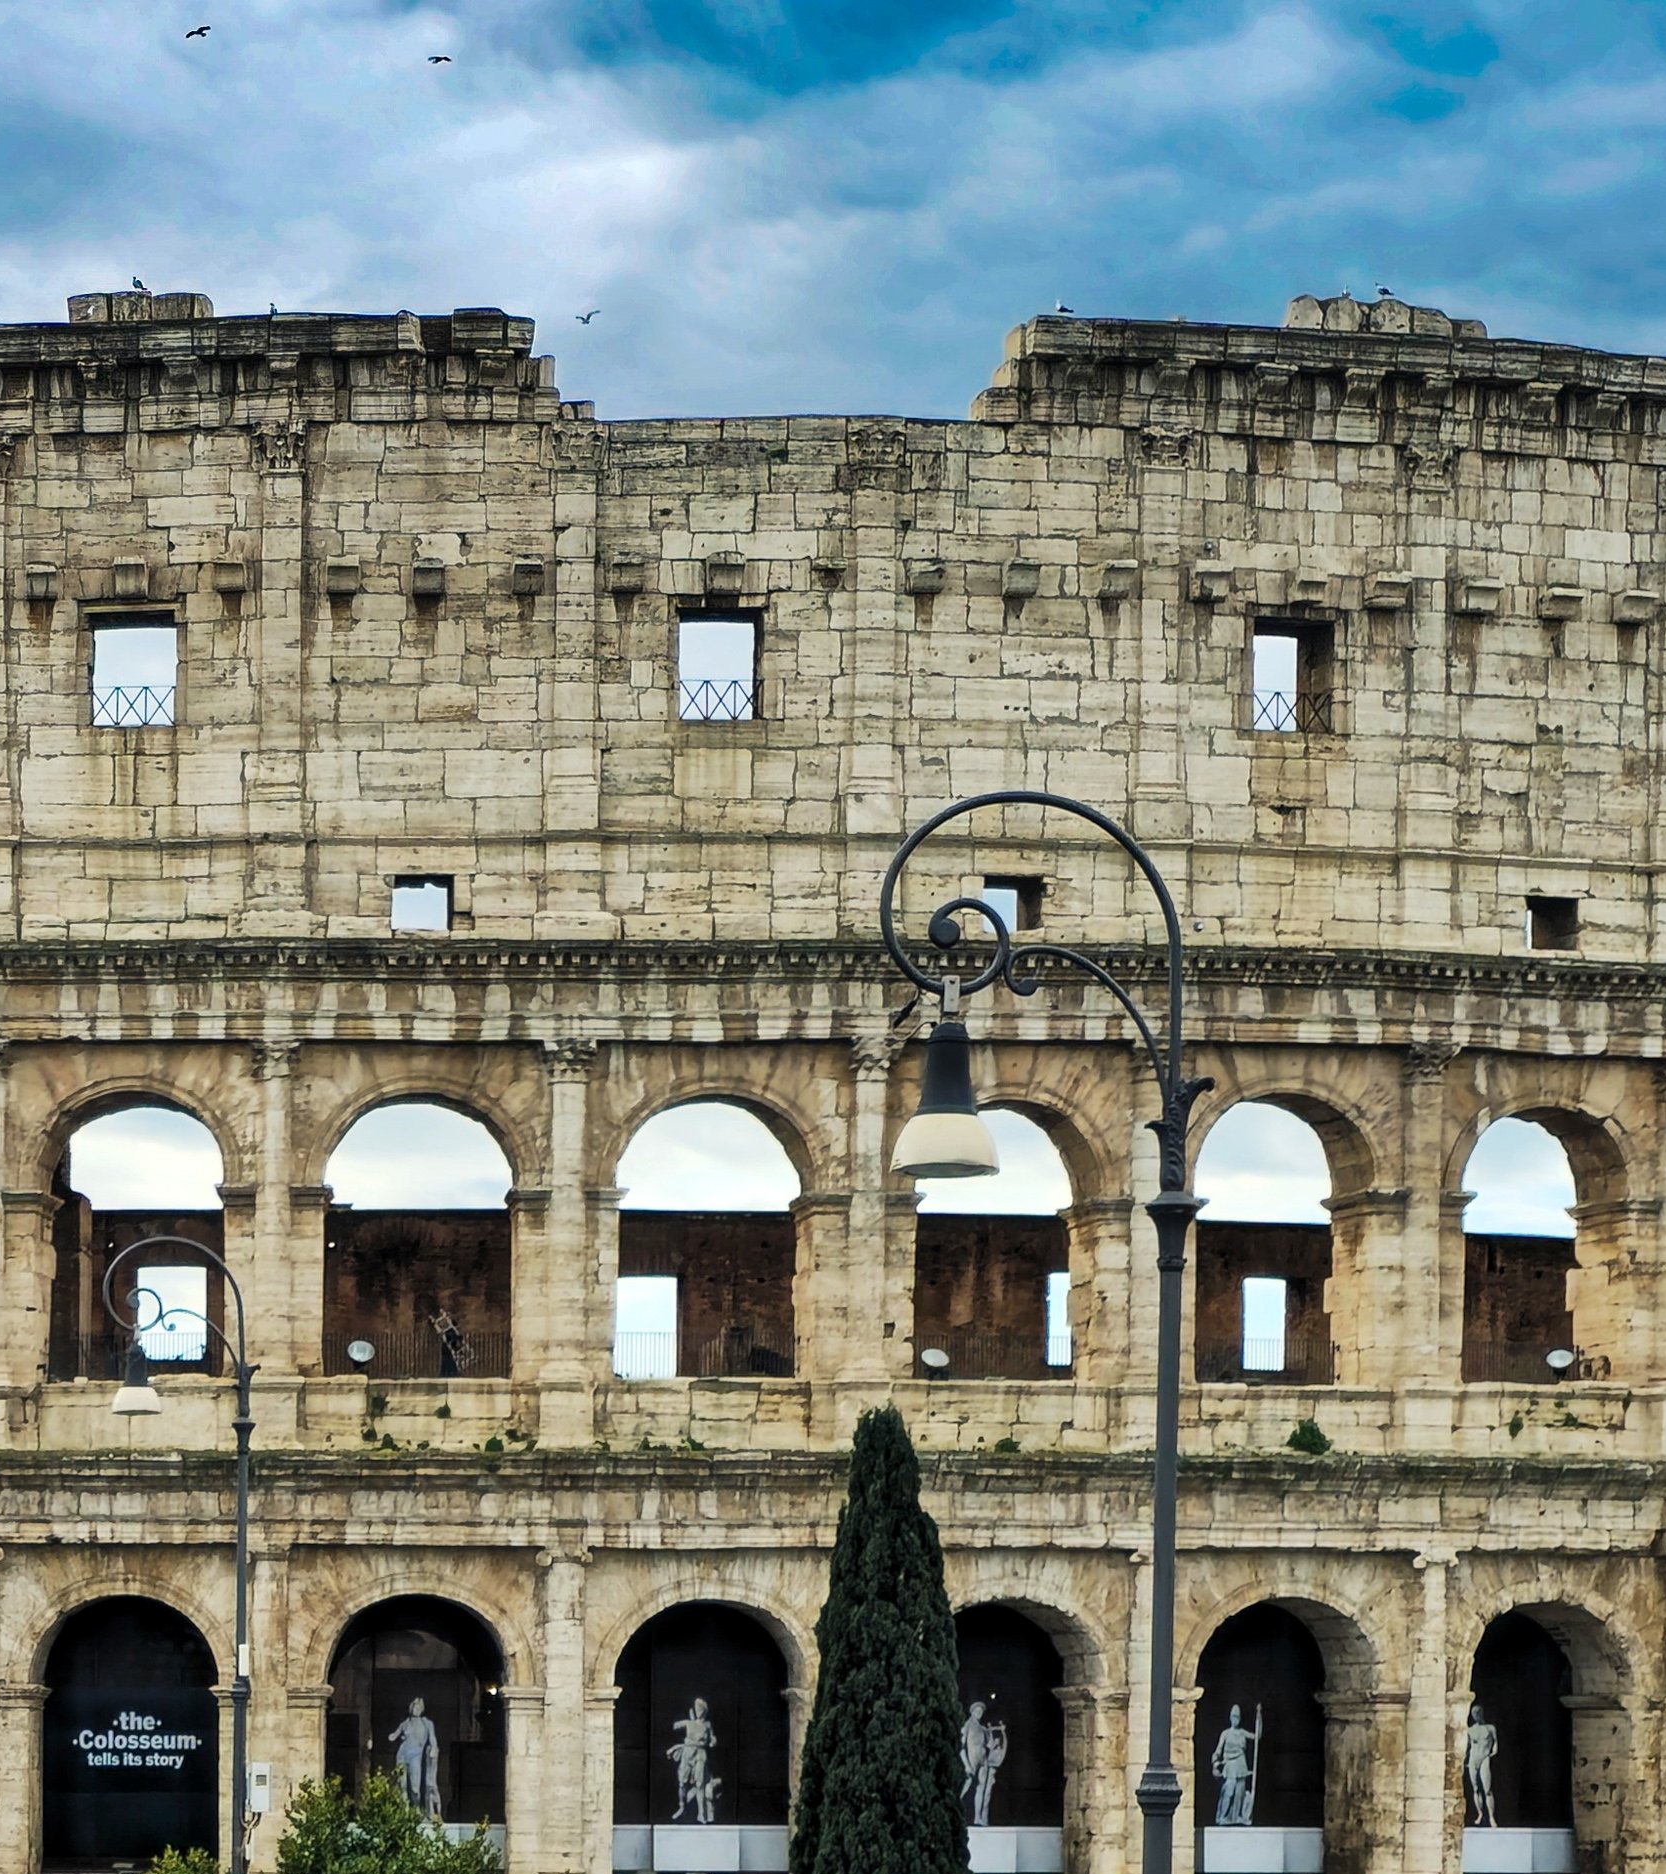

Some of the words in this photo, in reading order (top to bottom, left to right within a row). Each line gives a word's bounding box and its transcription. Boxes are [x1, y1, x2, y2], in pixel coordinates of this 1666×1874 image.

[119, 1711, 156, 1731] the
[78, 1729, 197, 1750] Colosseum
[87, 1752, 120, 1766] tells
[123, 1752, 142, 1766] its
[145, 1752, 184, 1770] story
